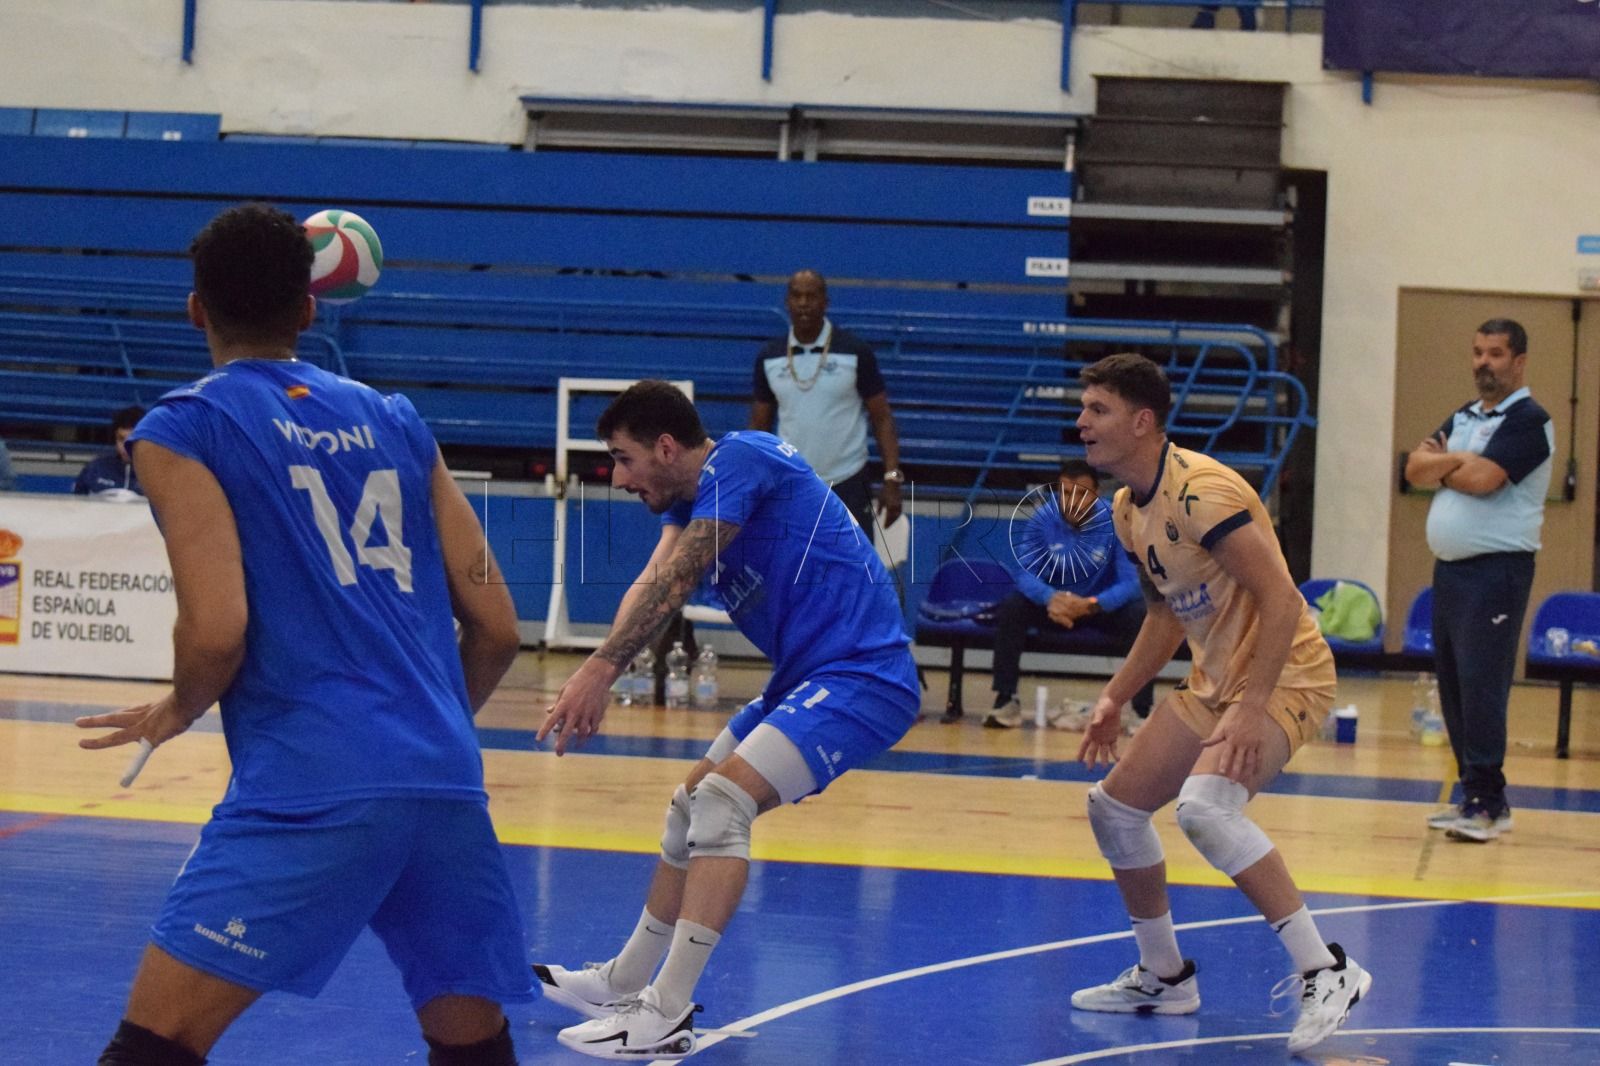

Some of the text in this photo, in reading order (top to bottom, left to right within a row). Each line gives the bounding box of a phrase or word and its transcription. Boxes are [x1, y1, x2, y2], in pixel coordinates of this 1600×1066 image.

[288, 465, 414, 593] 14
[1147, 544, 1168, 580] 4
[34, 570, 74, 589] REAL
[33, 593, 116, 616] ESPAÑOLA
[32, 621, 134, 643] DE VOLEIBOL
[232, 941, 267, 959] PRINT
